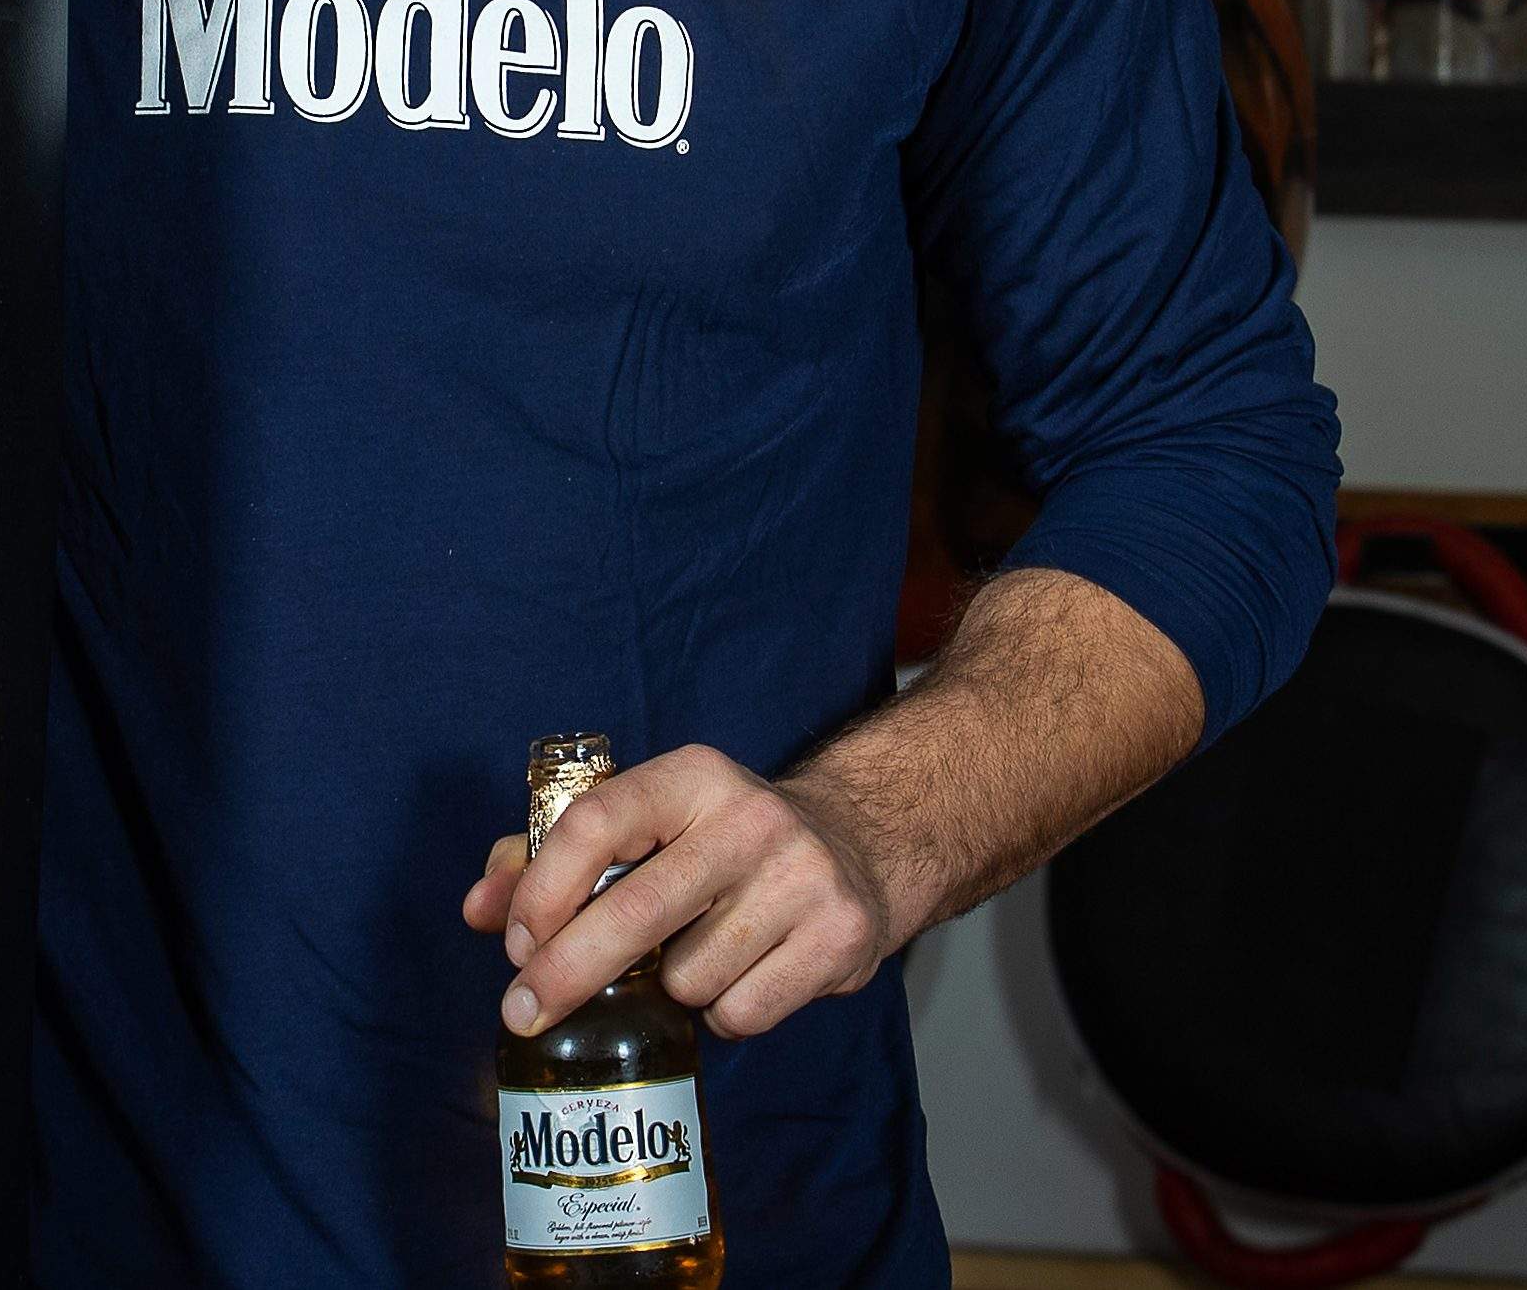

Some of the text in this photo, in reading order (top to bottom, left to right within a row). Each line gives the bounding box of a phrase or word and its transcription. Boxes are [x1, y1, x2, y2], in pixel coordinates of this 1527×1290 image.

[561, 1098, 620, 1115] CERVEZA
[521, 1107, 670, 1168] Modelo
[557, 1192, 637, 1221] Especial
